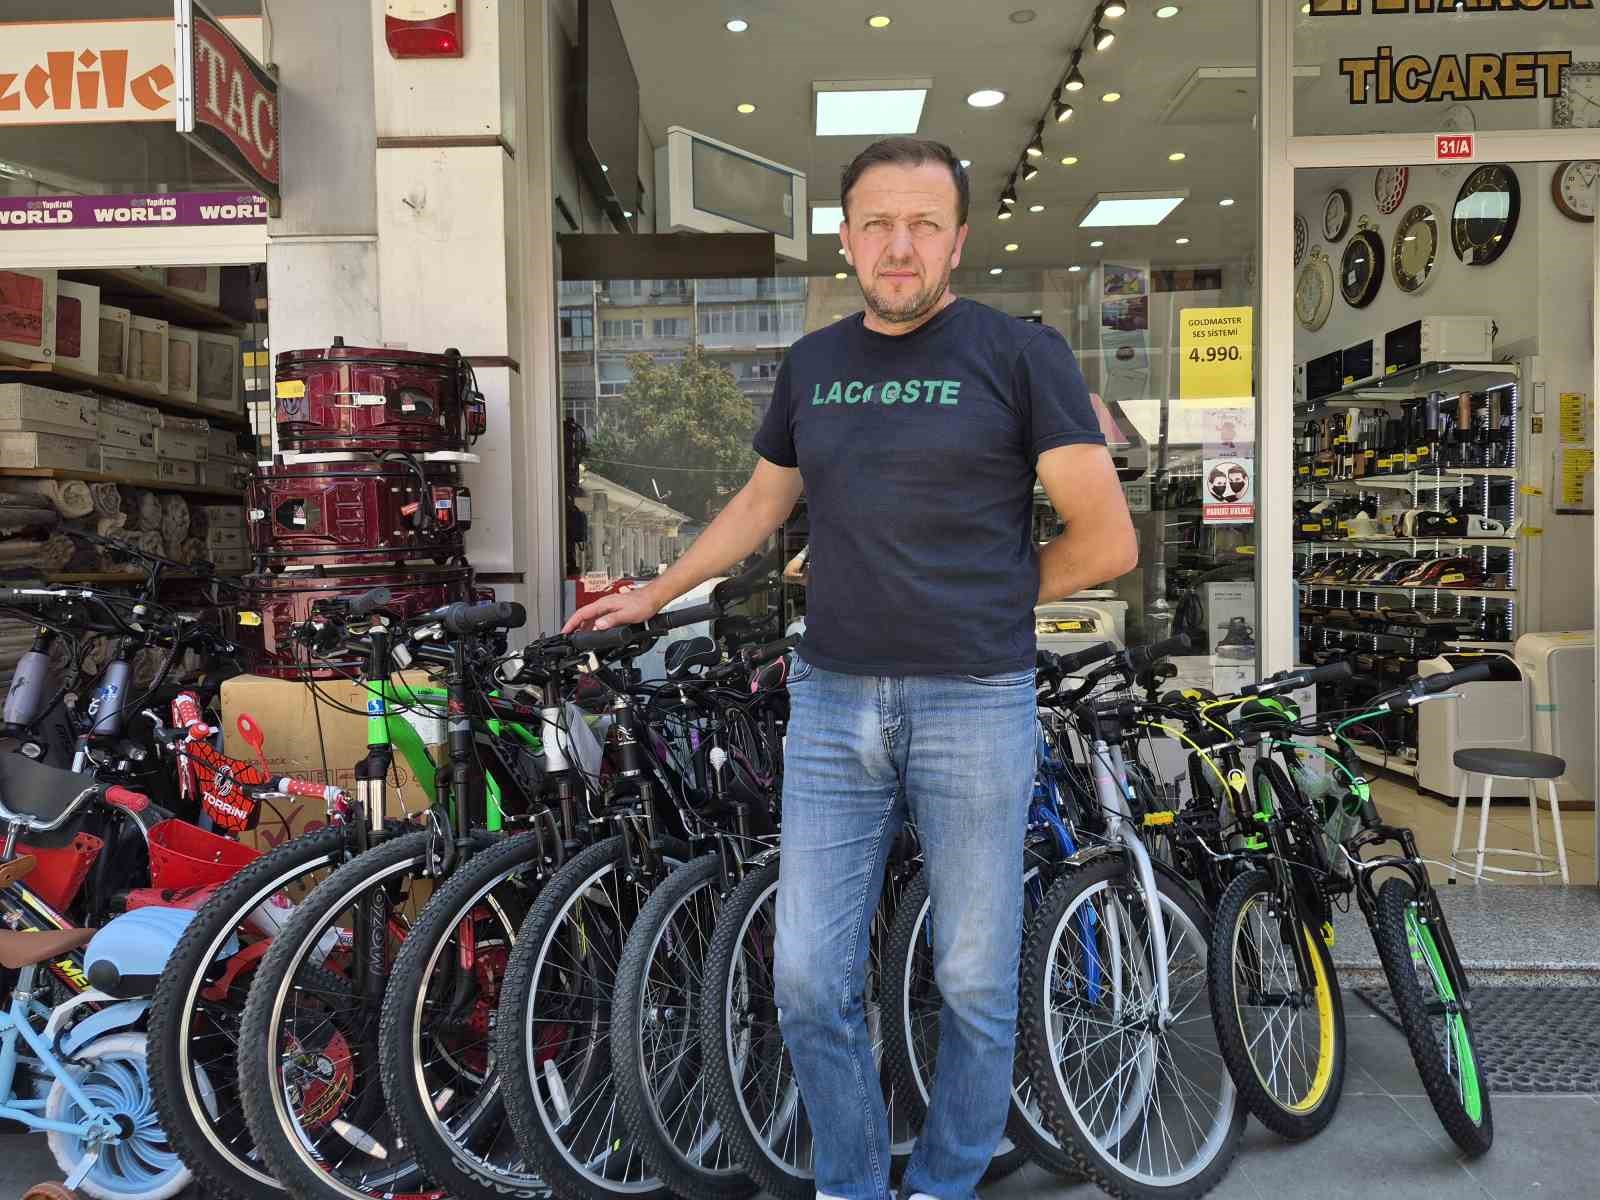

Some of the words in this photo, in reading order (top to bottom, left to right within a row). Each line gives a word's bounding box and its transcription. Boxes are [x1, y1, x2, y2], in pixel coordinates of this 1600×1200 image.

[1339, 46, 1572, 104] TİCARET
[1439, 139, 1470, 155] 31/A
[94, 207, 177, 222] WORLD
[1188, 317, 1242, 327] GOLDMASTER
[1192, 330, 1206, 338] SES
[1207, 328, 1238, 337] SİSTEMİ
